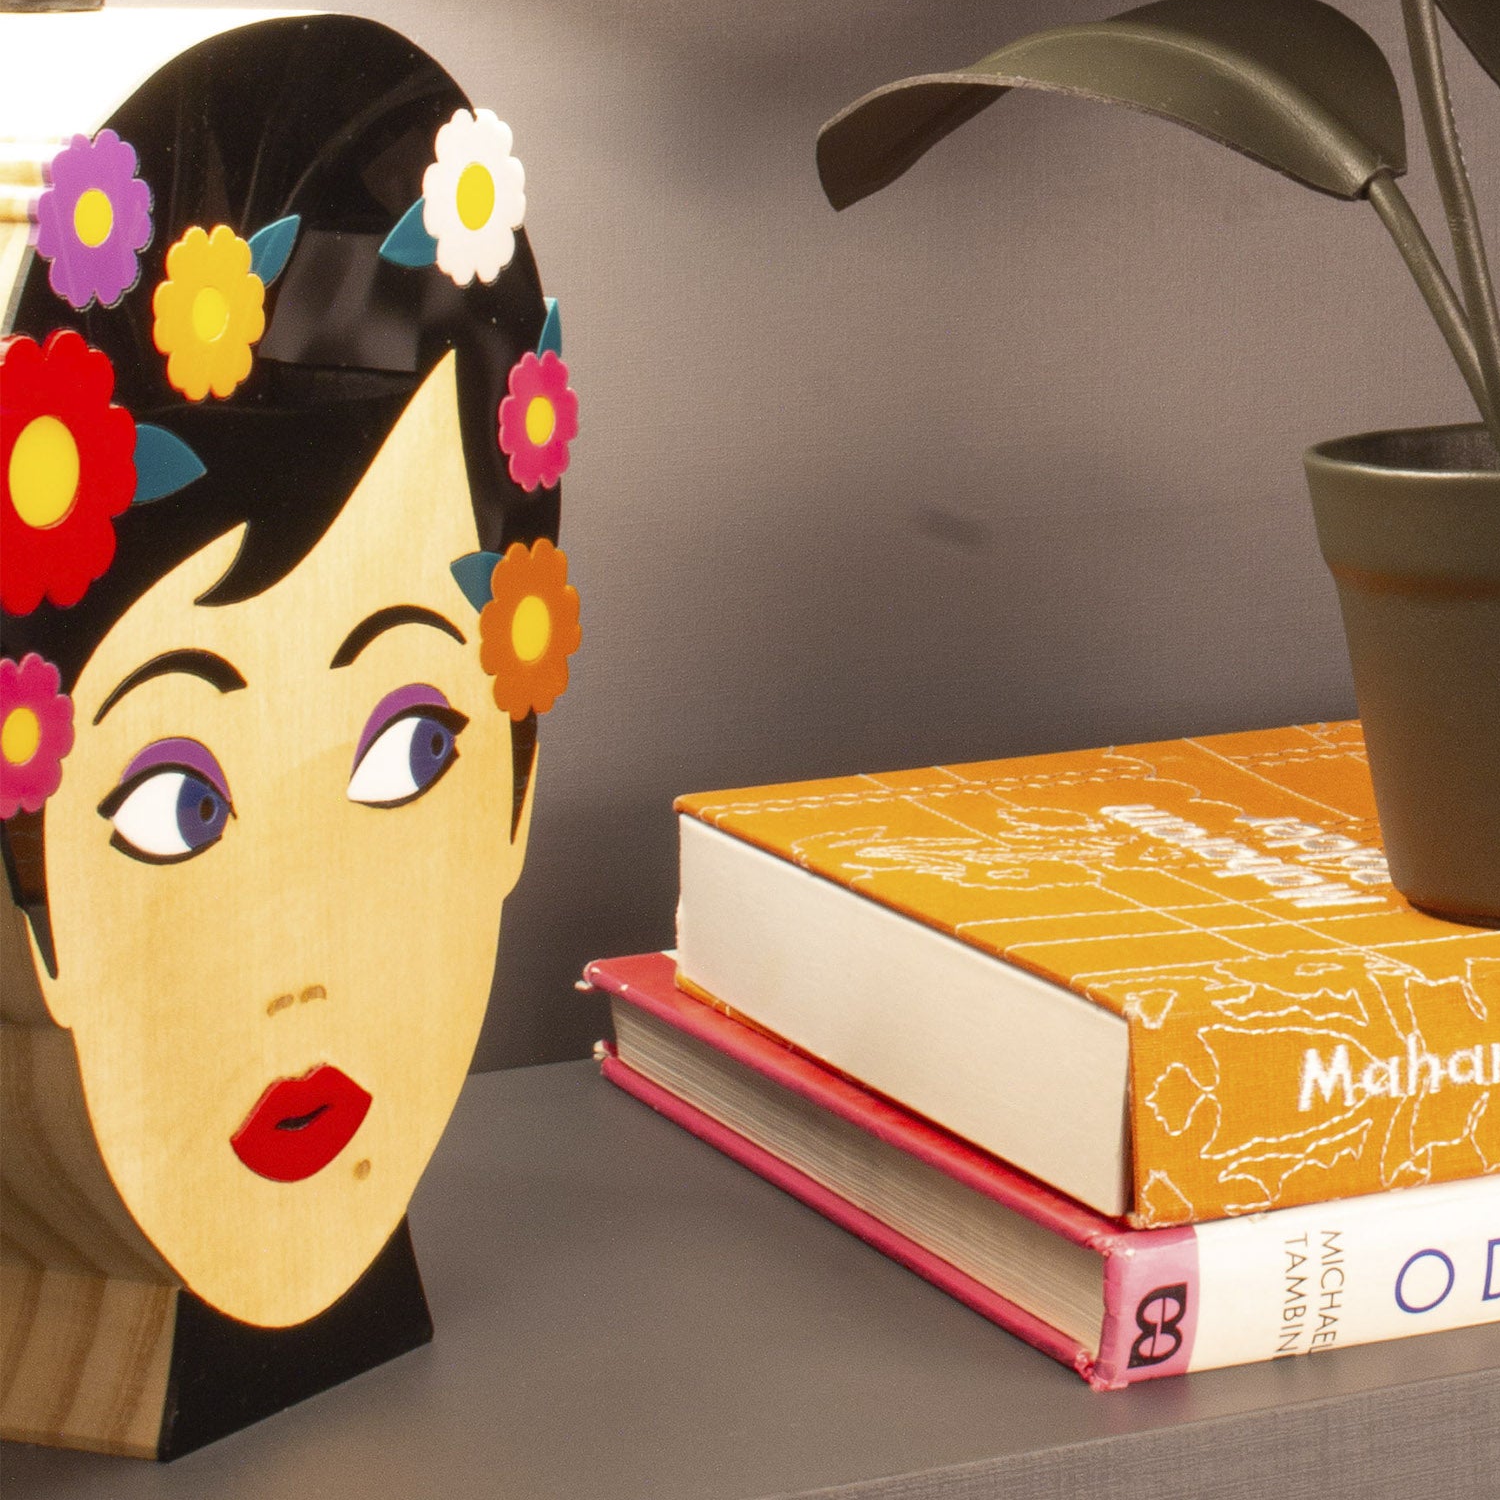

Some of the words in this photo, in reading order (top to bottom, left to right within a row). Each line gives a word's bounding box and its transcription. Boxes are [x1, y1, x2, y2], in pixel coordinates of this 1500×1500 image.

[1275, 1231, 1308, 1355] TAMBIN
[1309, 1230, 1345, 1353] MICHAEL
[1395, 1248, 1455, 1314] O
